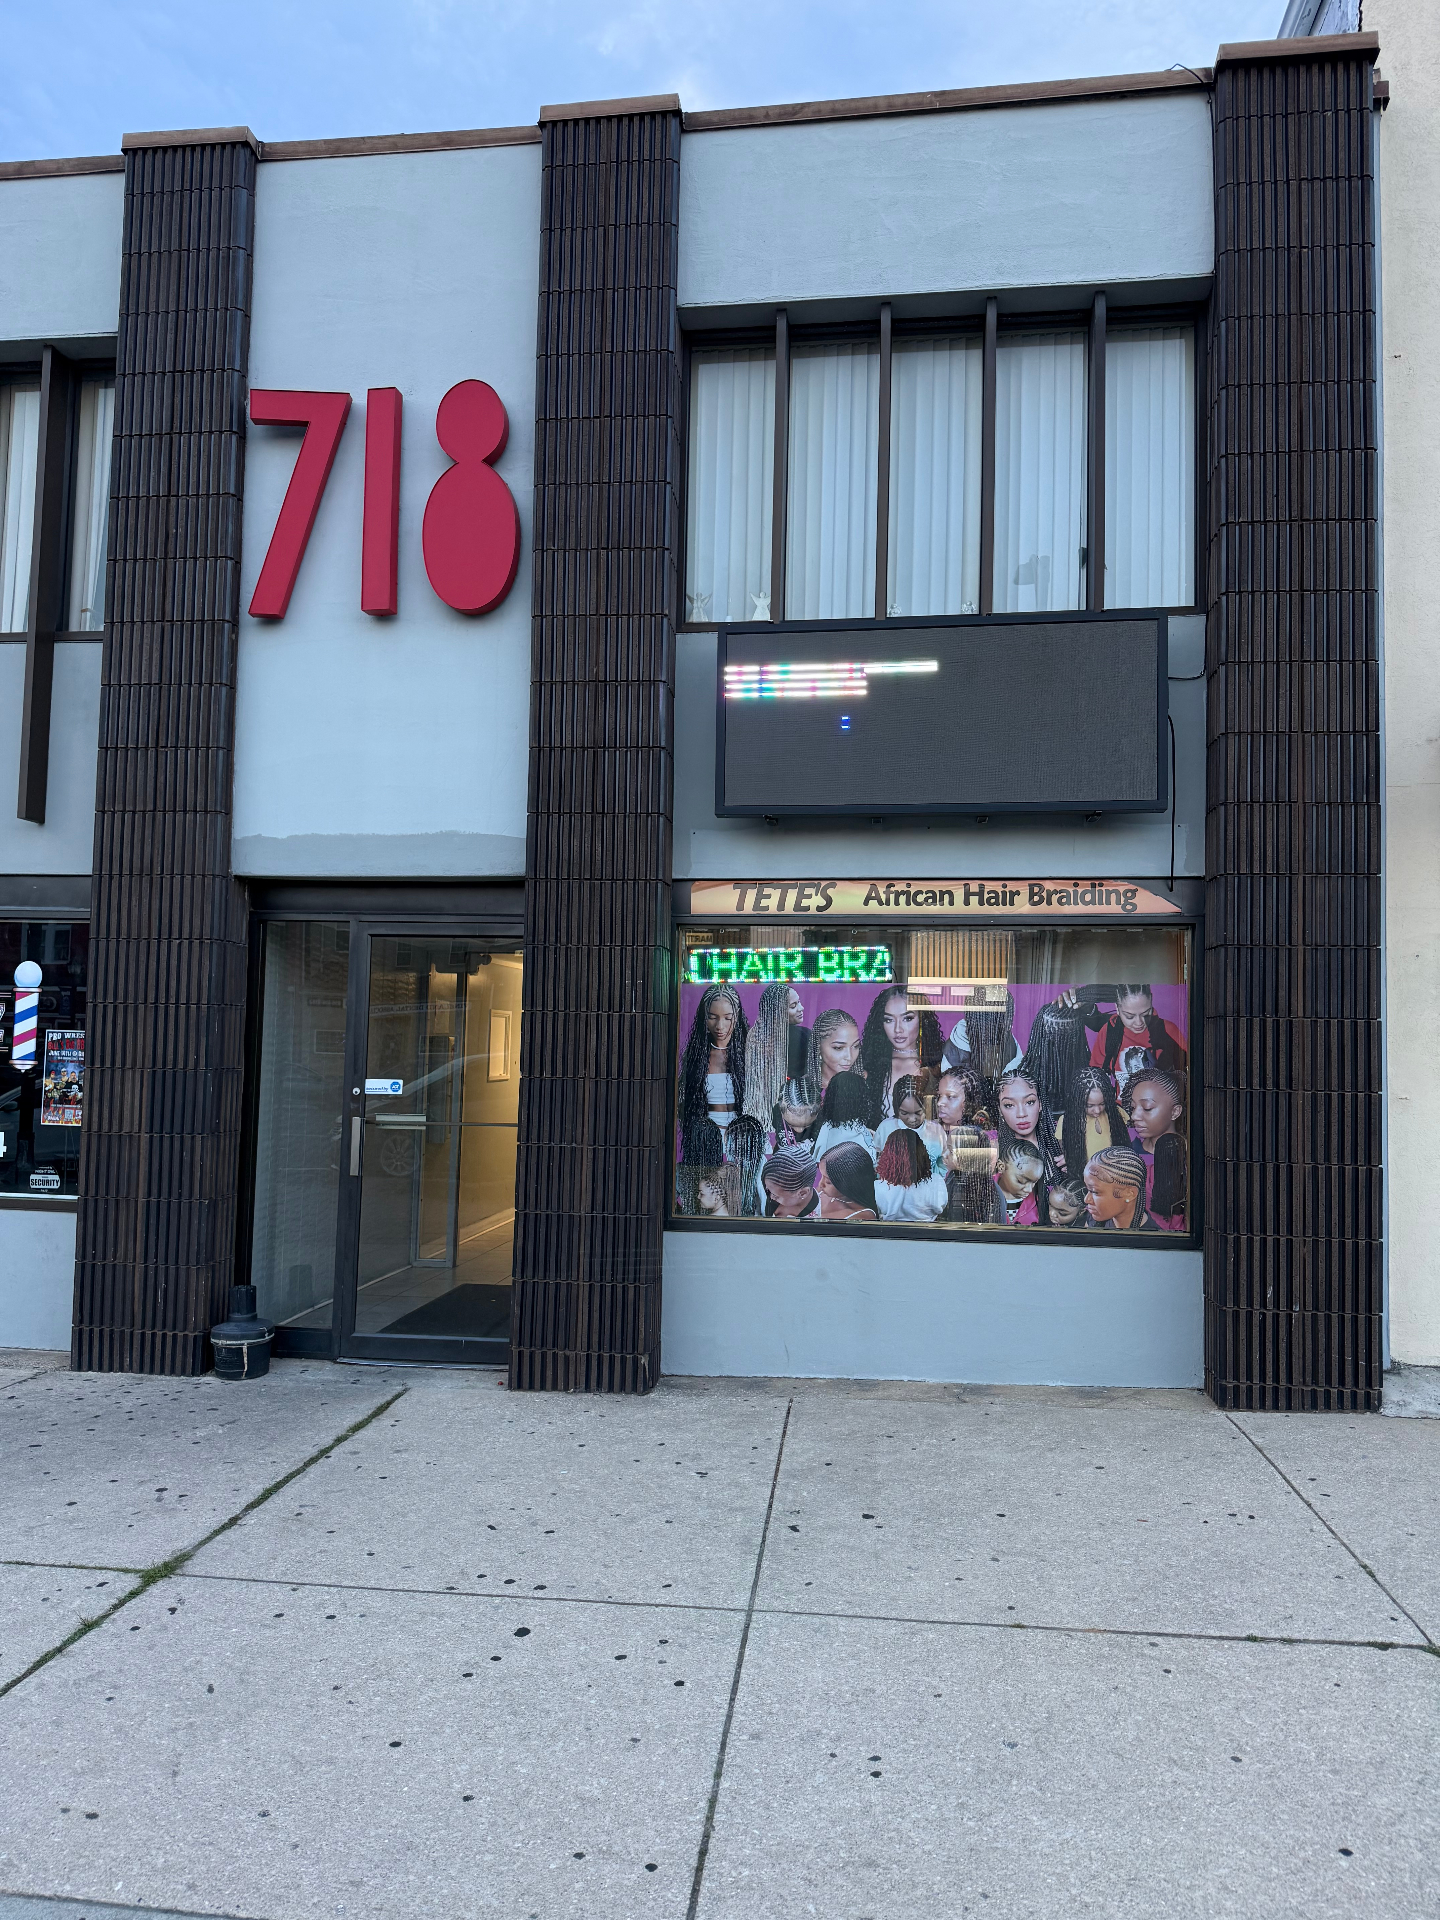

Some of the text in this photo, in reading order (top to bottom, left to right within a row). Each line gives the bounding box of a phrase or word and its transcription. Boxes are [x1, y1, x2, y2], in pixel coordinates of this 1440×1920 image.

[249, 379, 521, 619] 718
[733, 881, 1138, 913] TETE'S African Hair Braiding
[712, 948, 803, 981] HAIR
[31, 1178, 60, 1187] SECURITY
